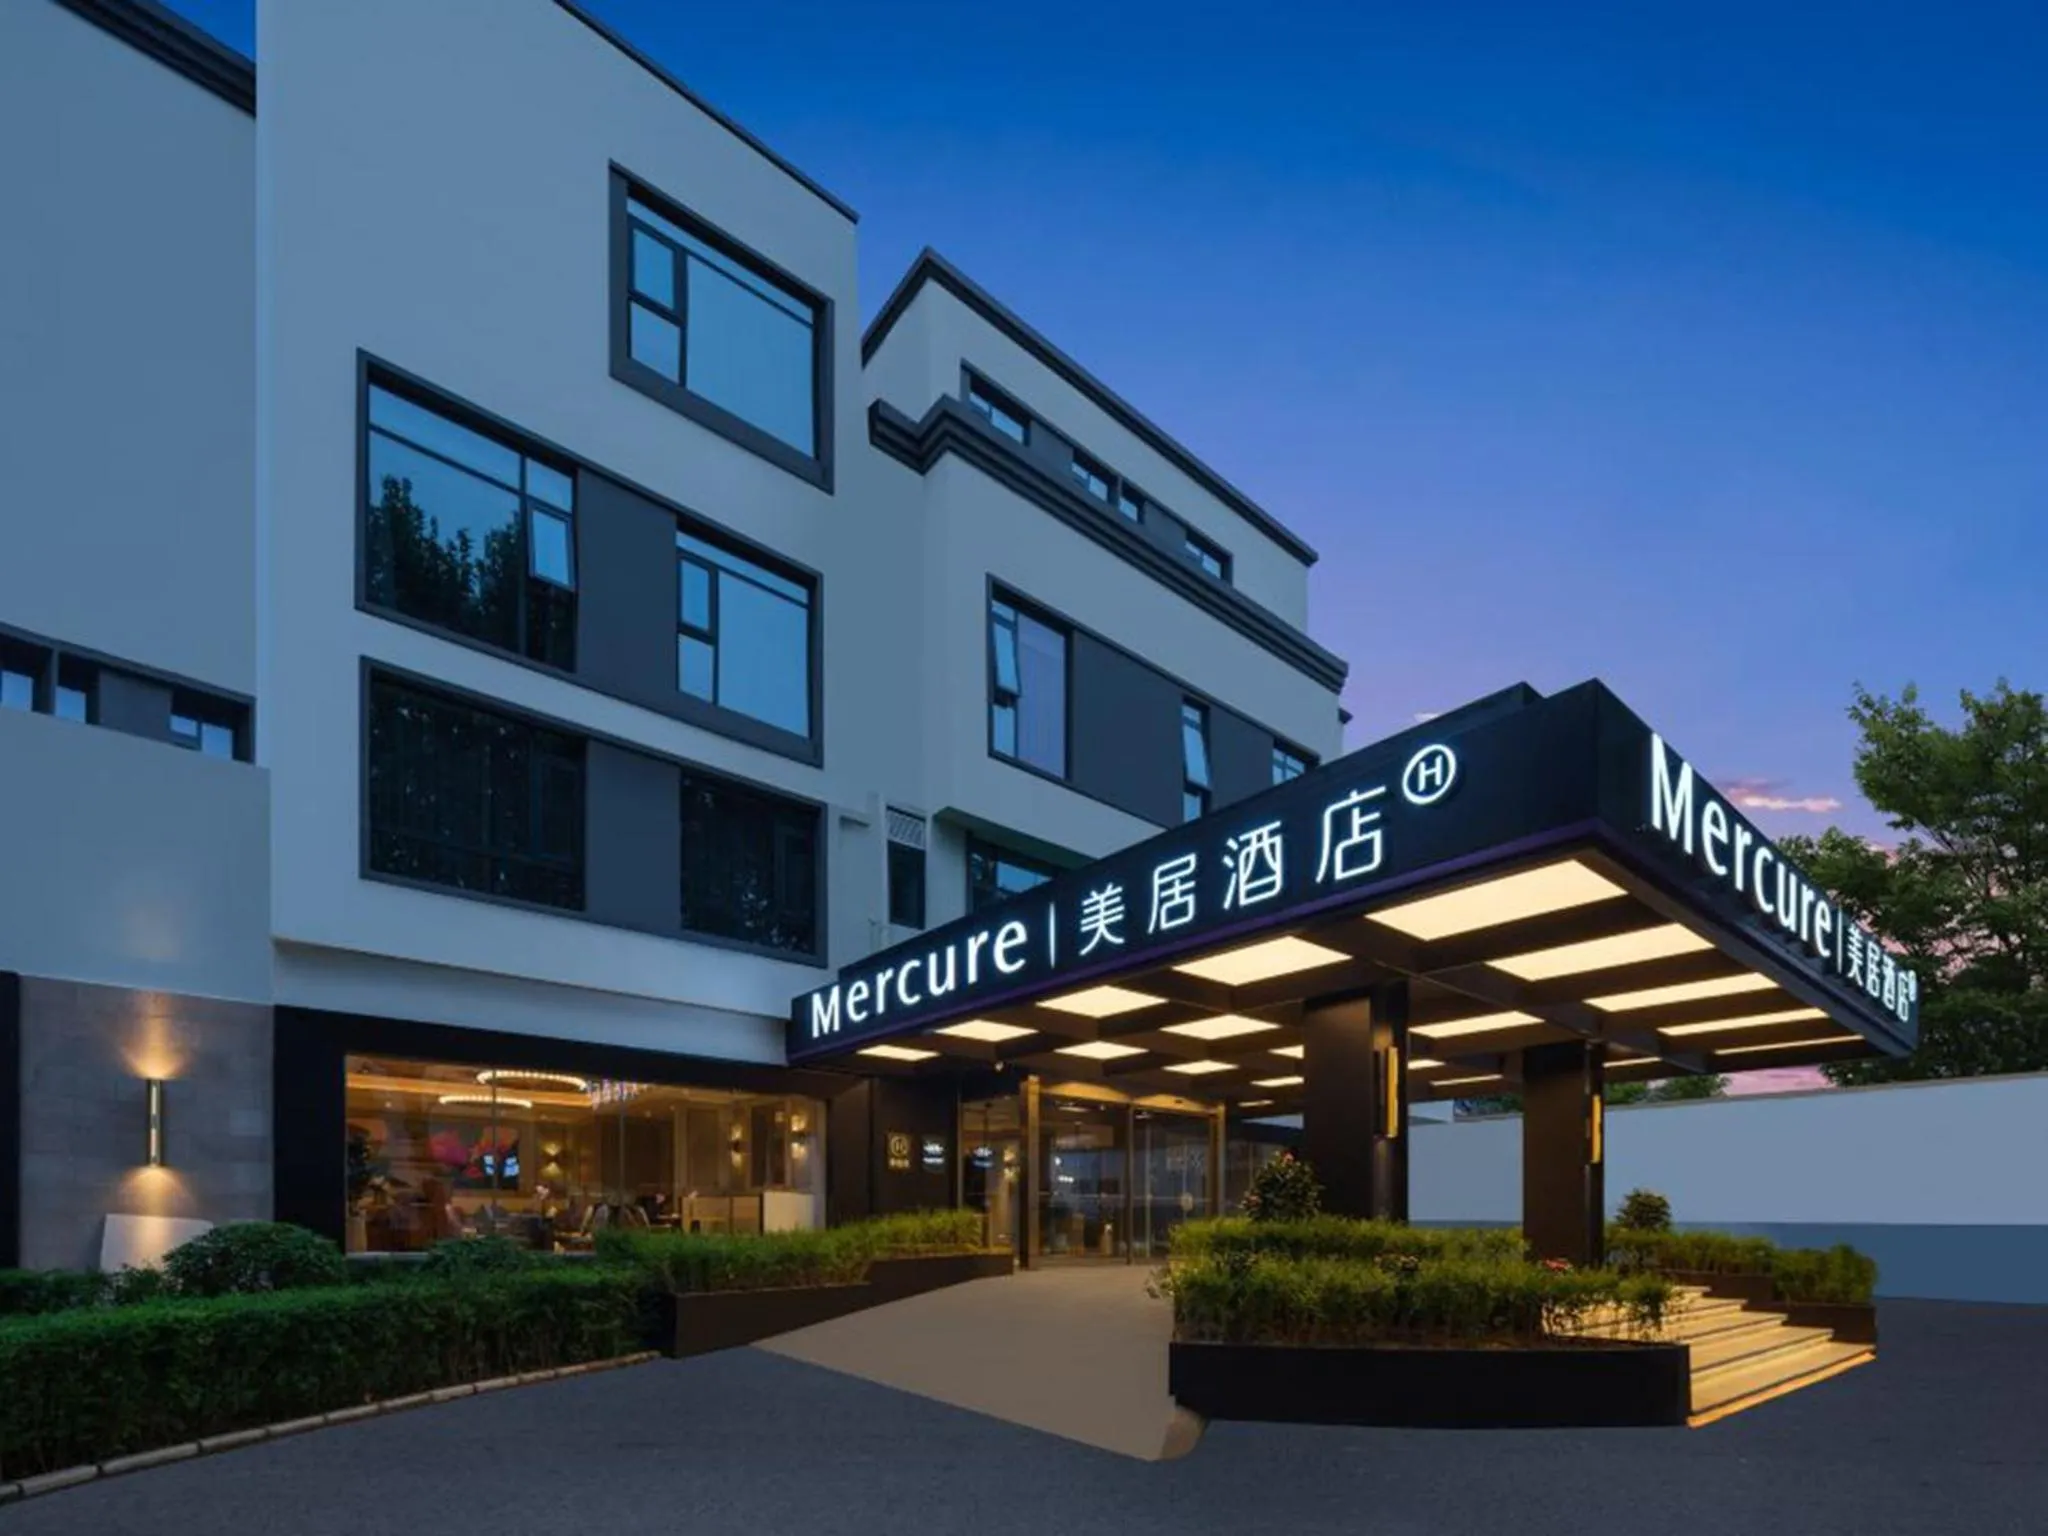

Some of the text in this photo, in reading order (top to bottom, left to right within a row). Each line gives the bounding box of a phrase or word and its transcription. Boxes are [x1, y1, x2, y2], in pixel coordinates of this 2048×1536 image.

[811, 920, 1028, 1038] Mercure
[1080, 785, 1386, 956] 美居酒店
[1652, 732, 1832, 958] Mercure
